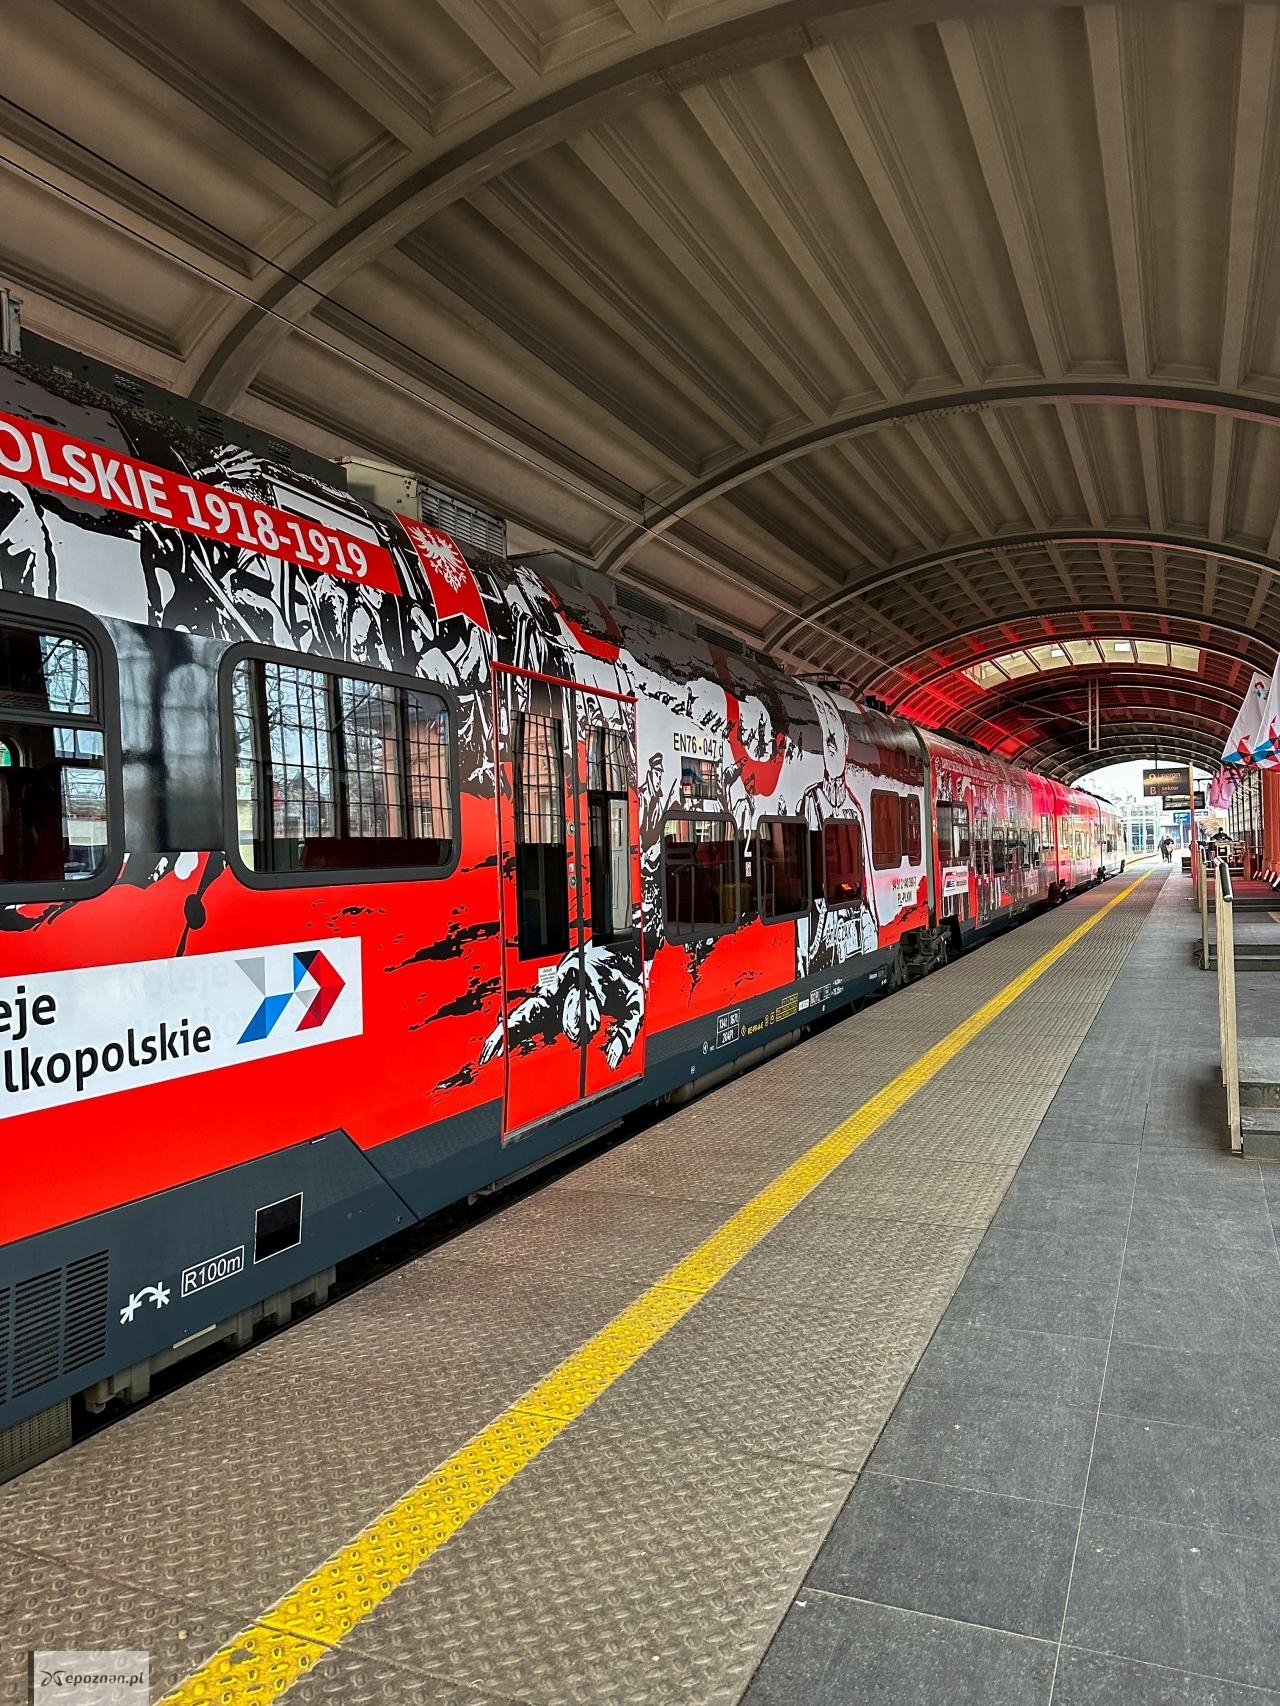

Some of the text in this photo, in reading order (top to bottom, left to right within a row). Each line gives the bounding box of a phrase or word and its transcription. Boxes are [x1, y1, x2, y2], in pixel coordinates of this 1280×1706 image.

[179, 484, 367, 577] 1918-1919
[673, 732, 697, 754] EN76
[1150, 786, 1157, 795] B
[4, 1018, 212, 1093] lkopolskie
[184, 1256, 240, 1292] R100m
